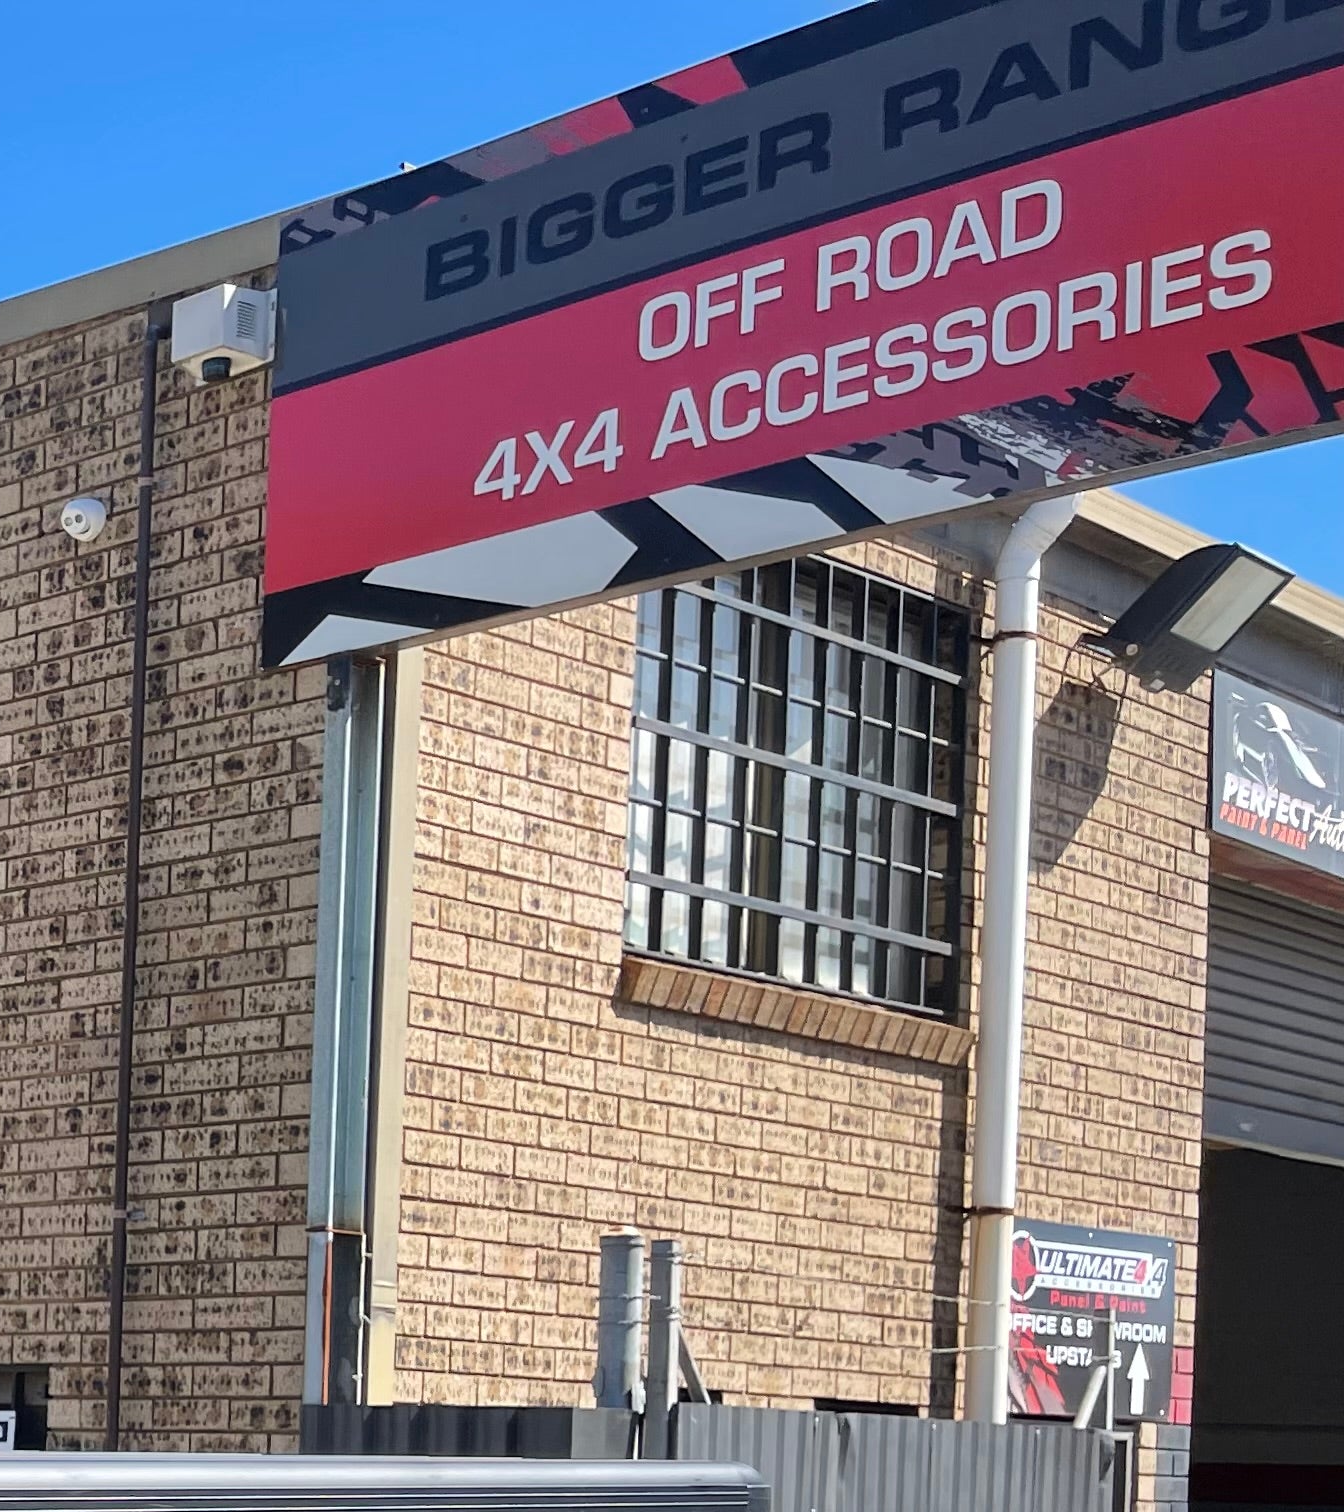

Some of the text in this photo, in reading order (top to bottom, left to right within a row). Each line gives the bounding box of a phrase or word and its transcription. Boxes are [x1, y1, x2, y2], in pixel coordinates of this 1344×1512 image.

[424, 0, 1344, 302] BIGGER RANG
[637, 178, 1064, 363] OFF ROAD
[472, 229, 1274, 501] 4X4 ACCESSORIES
[1222, 771, 1315, 832] PERFECT
[1010, 1312, 1058, 1336] FFICE
[1060, 1316, 1074, 1337] &
